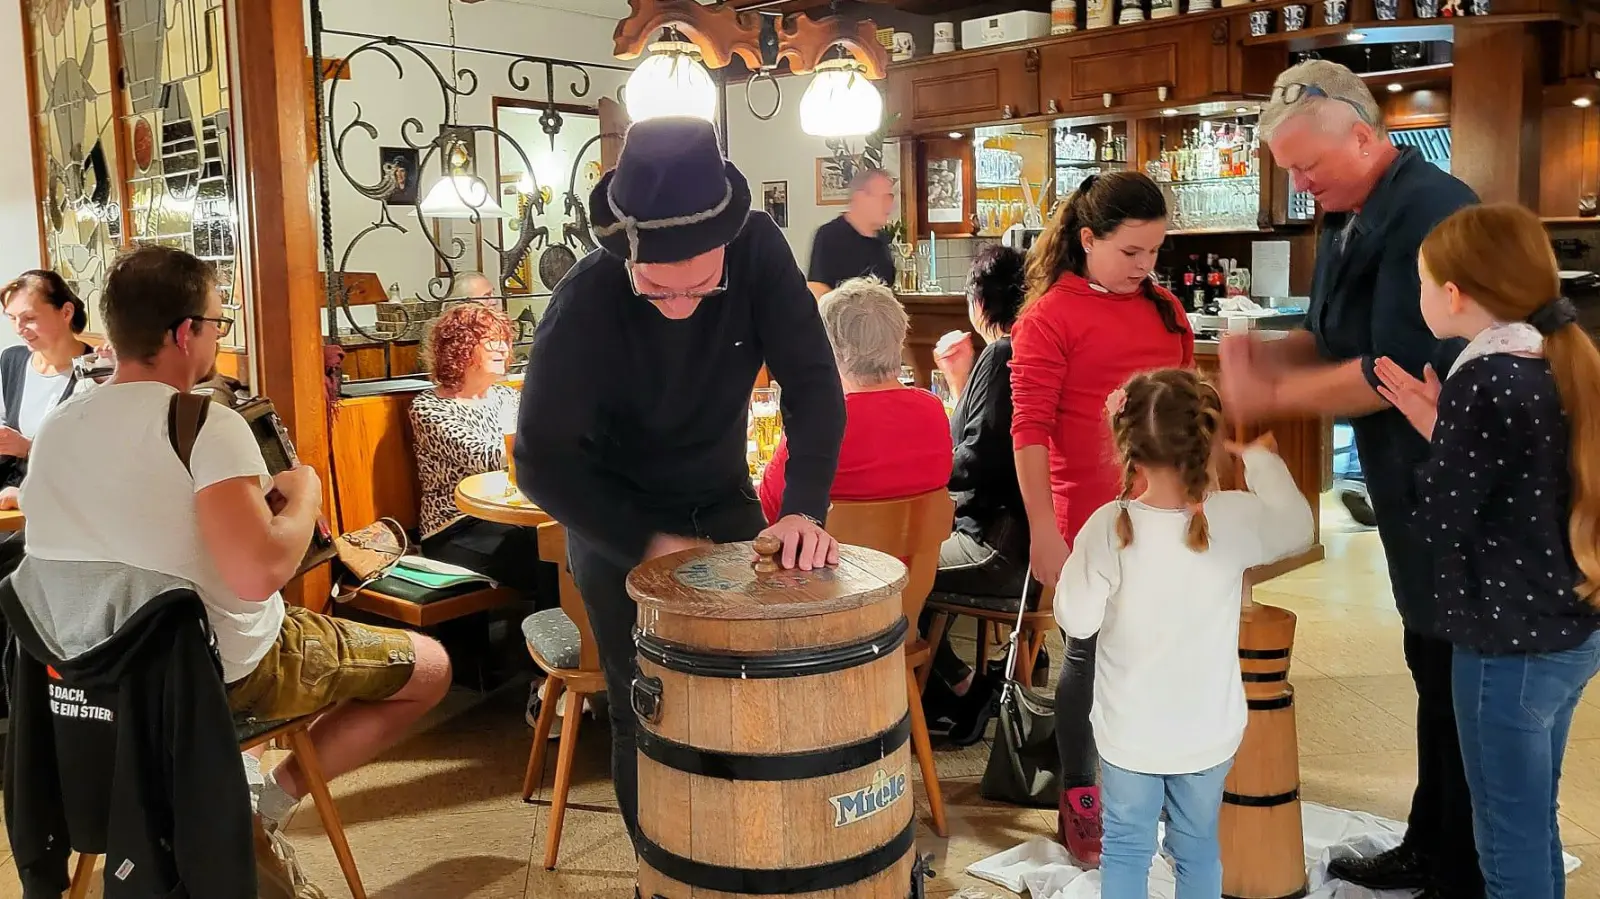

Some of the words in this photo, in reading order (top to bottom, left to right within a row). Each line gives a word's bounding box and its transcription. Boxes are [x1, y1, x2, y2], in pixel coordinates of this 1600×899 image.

[54, 686, 88, 704] DACH,
[60, 703, 79, 717] EIN
[837, 773, 905, 825] Miele
